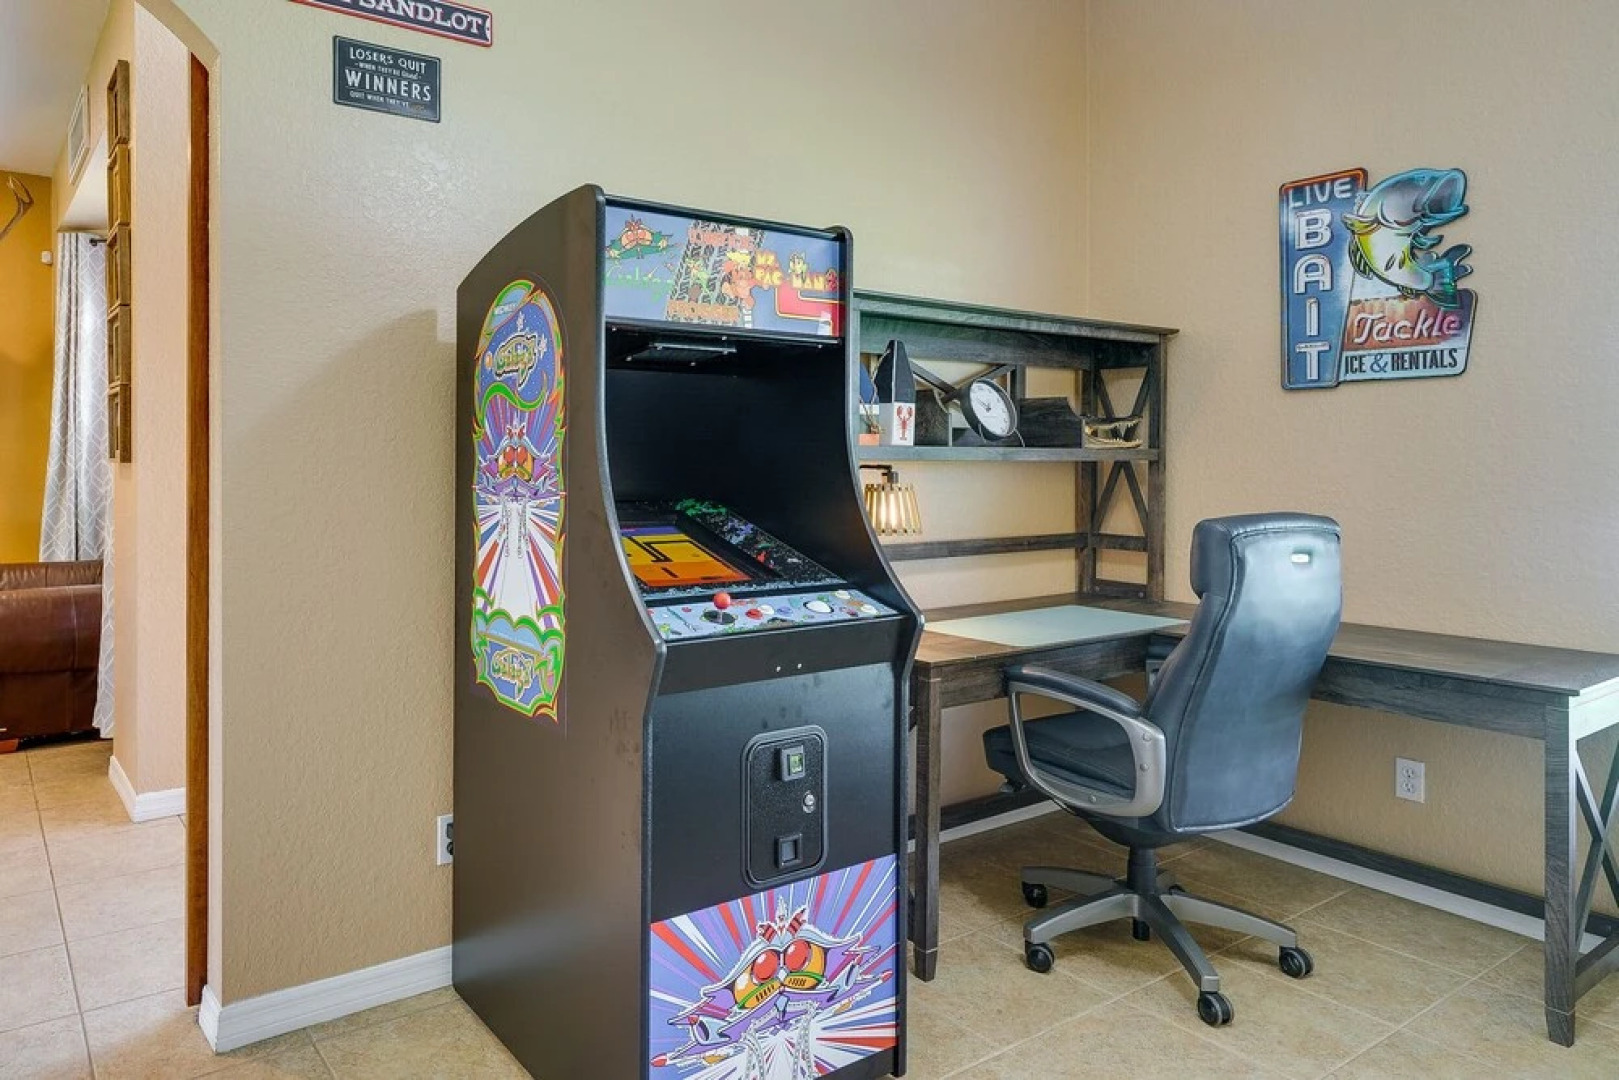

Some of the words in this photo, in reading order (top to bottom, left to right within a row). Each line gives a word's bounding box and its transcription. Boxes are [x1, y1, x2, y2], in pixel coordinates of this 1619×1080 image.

[349, 46, 394, 65] LOSERS
[398, 57, 427, 74] QUIT
[358, 62, 377, 72] WHEN
[344, 68, 432, 102] WINNERS
[1288, 177, 1354, 208] LIVE
[1293, 208, 1334, 381] BAIT
[1352, 308, 1463, 344] Tackle
[1344, 353, 1367, 375] ICE
[1369, 352, 1389, 373] &
[1391, 347, 1458, 372] RENTALS
